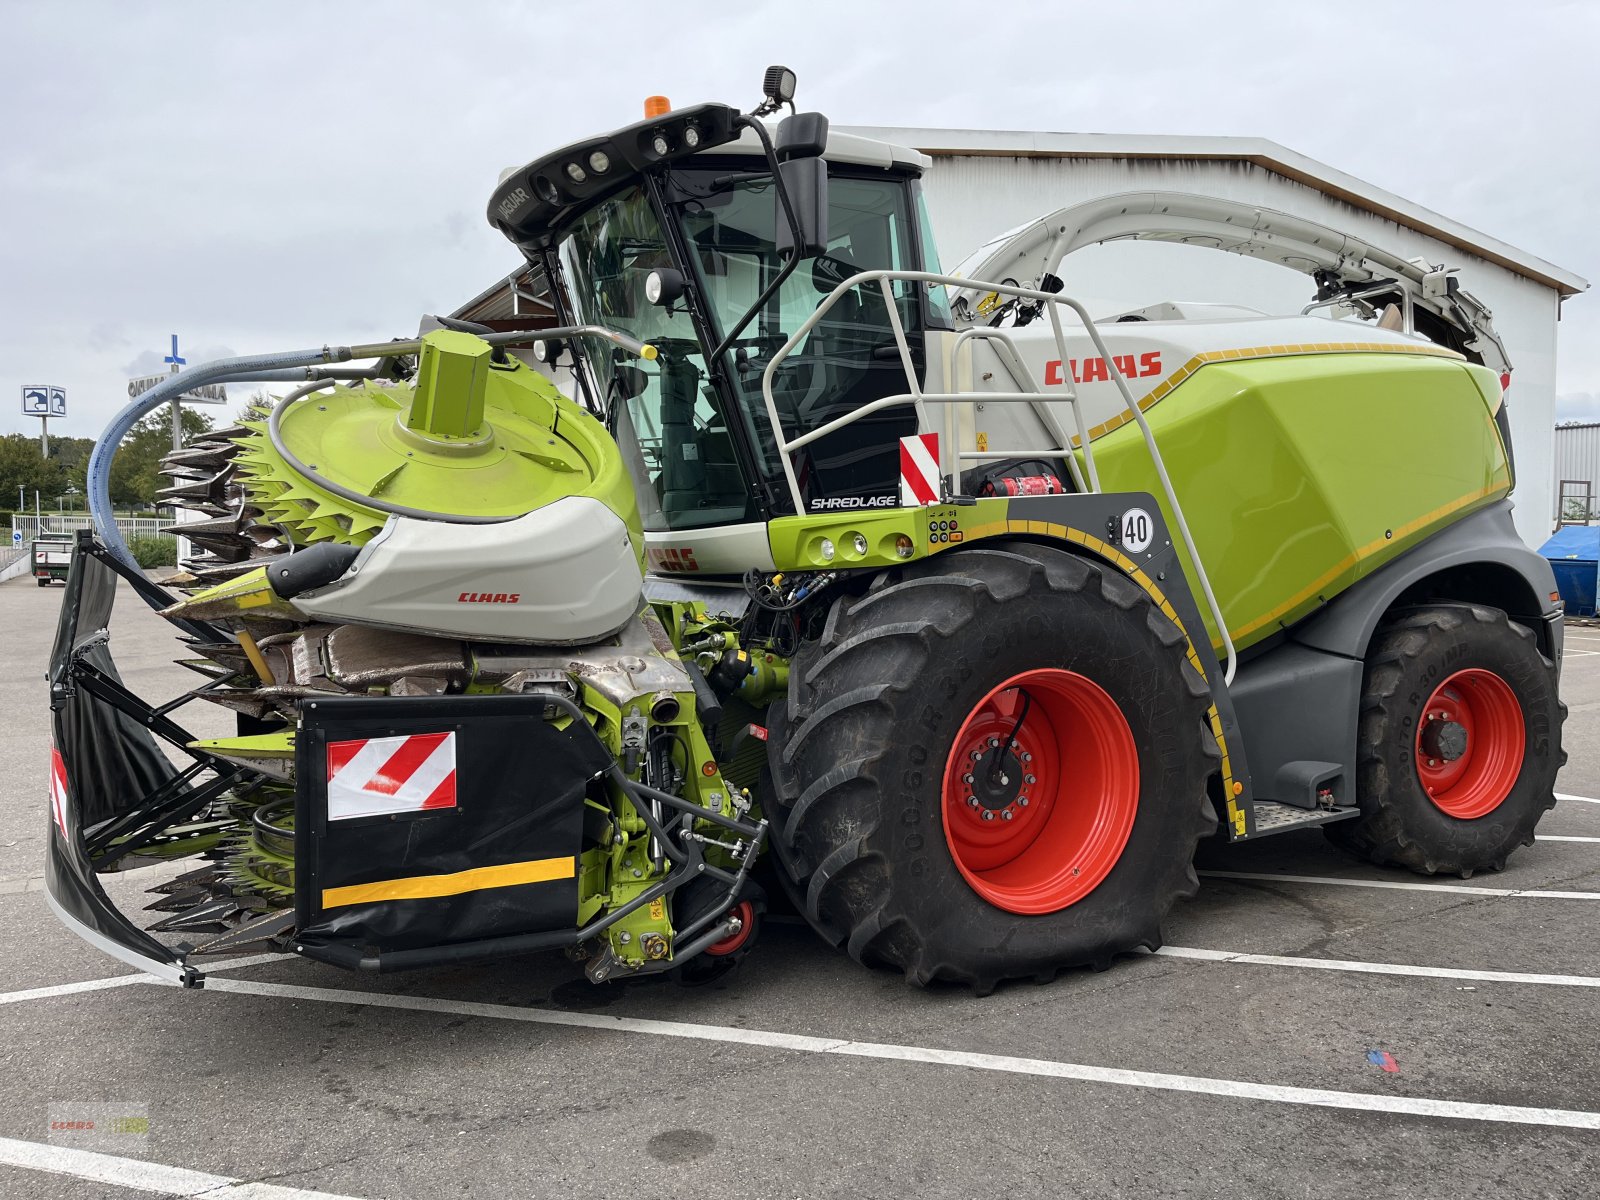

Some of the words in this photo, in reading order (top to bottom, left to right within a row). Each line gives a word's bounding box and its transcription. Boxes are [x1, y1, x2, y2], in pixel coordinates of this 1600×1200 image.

[498, 188, 530, 220] JAGUAR
[1045, 351, 1162, 385] CLAAS
[811, 496, 896, 509] SHREDLAGE
[1125, 515, 1147, 543] 40
[458, 592, 520, 603] CLAAS
[1408, 691, 1420, 706] R
[1420, 666, 1438, 688] 30
